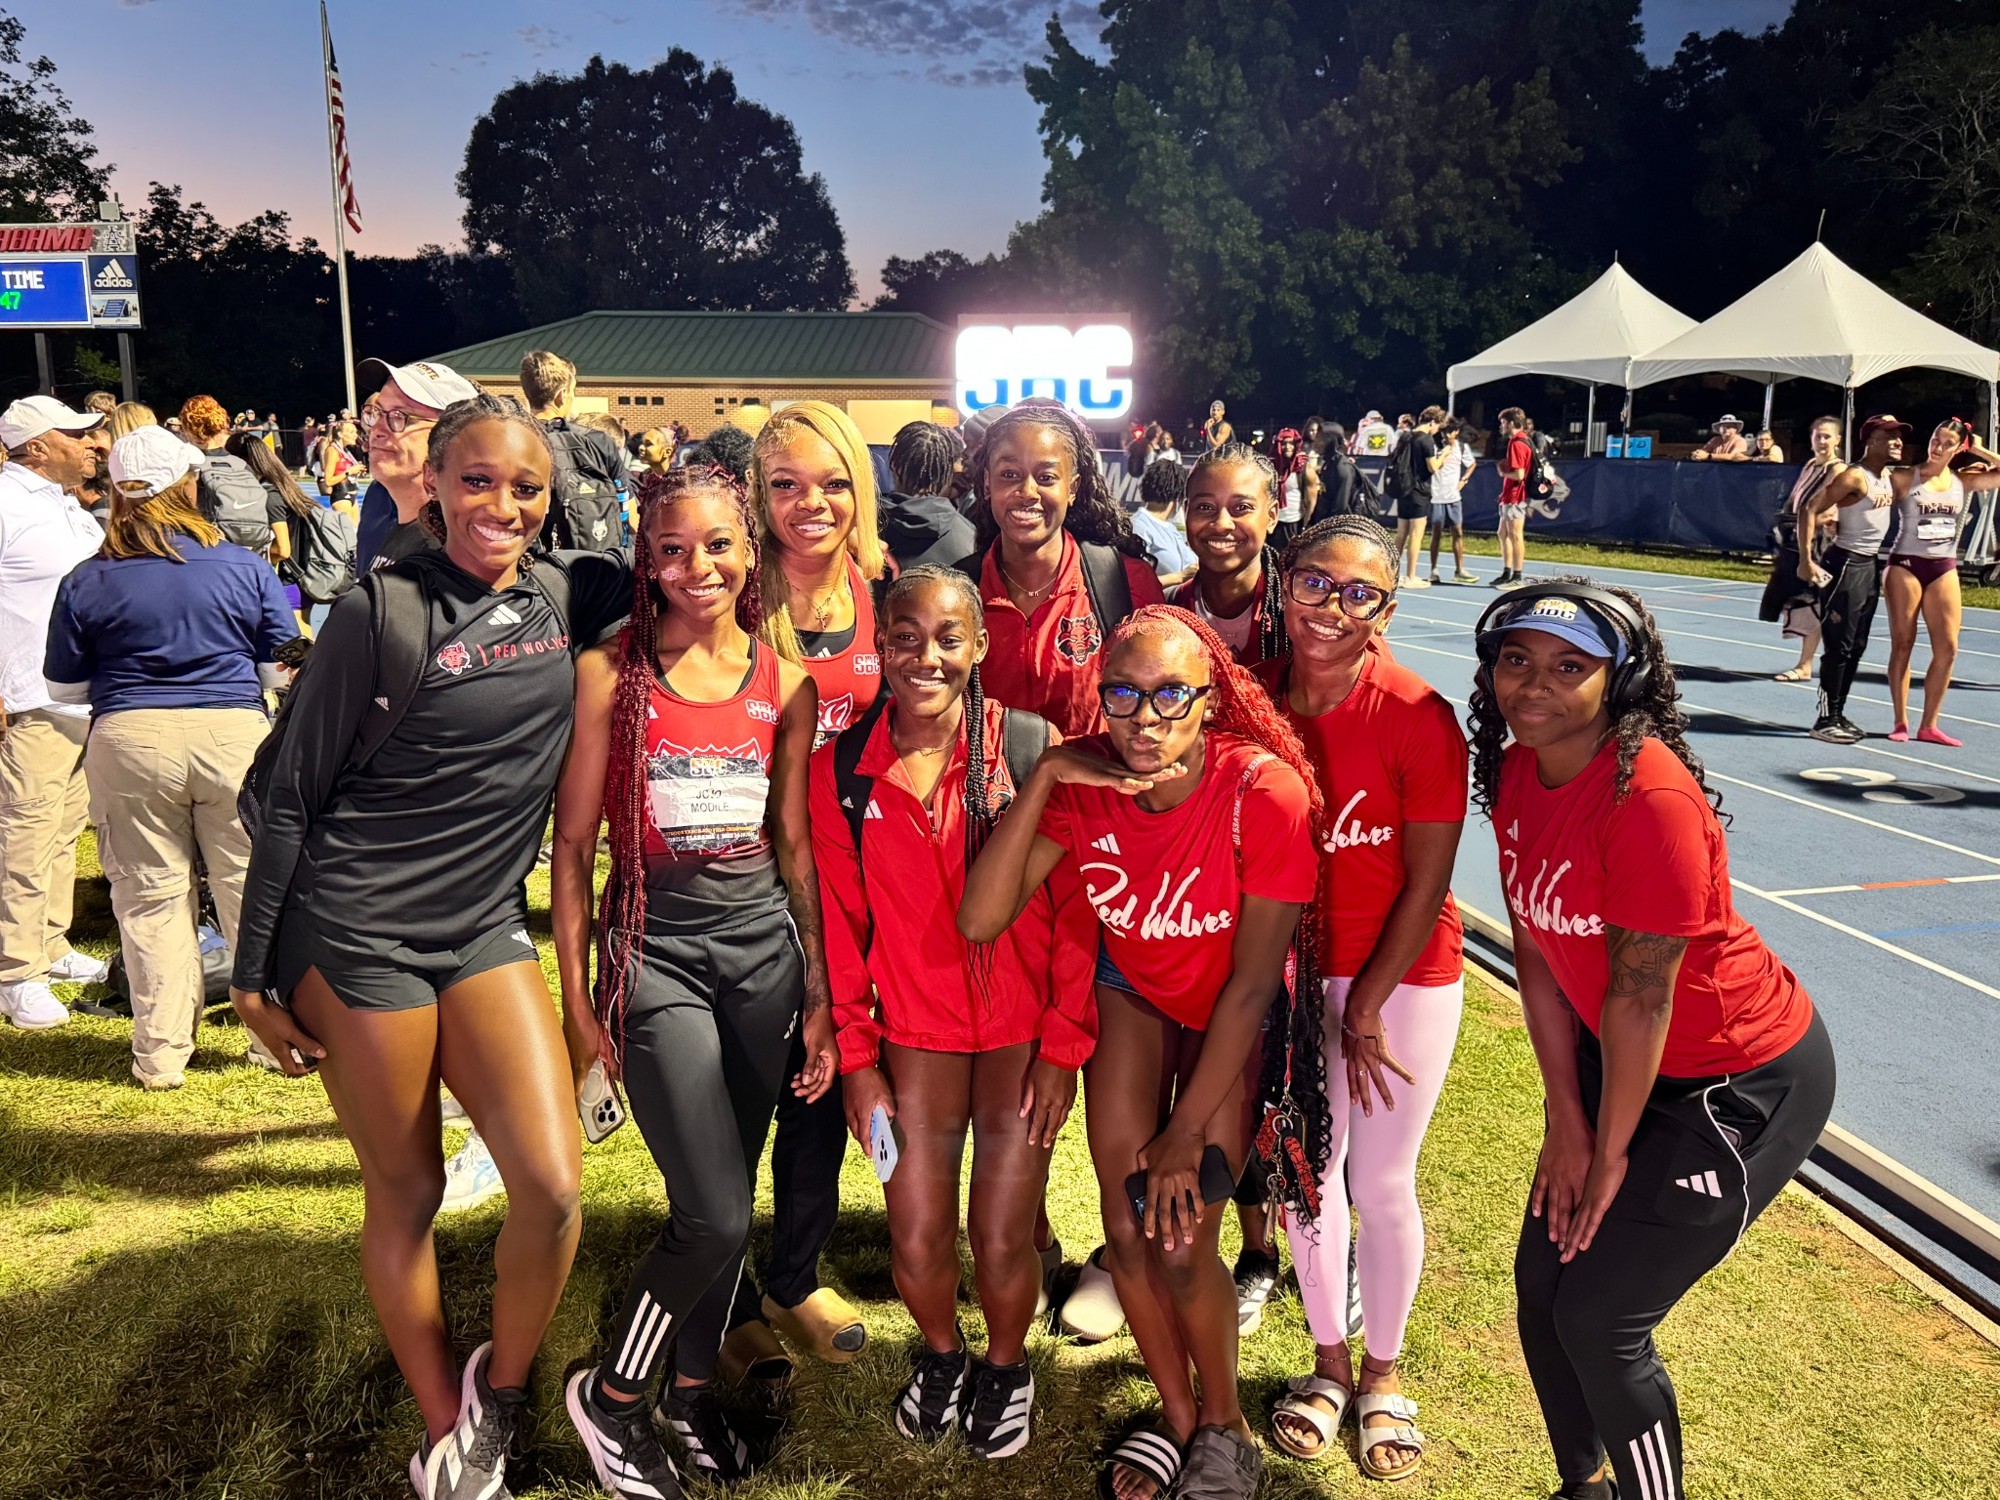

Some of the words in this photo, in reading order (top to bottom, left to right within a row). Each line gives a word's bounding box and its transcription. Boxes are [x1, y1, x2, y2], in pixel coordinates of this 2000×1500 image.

[1, 270, 45, 289] TIME
[94, 278, 133, 288] adidas
[493, 644, 518, 658] RED
[853, 654, 880, 674] SBC
[1232, 800, 1241, 834] WOLVES
[1231, 834, 1242, 846] UP
[1079, 862, 1138, 939] Red
[1140, 866, 1233, 941] Wolves
[1528, 858, 1606, 937] Wolves
